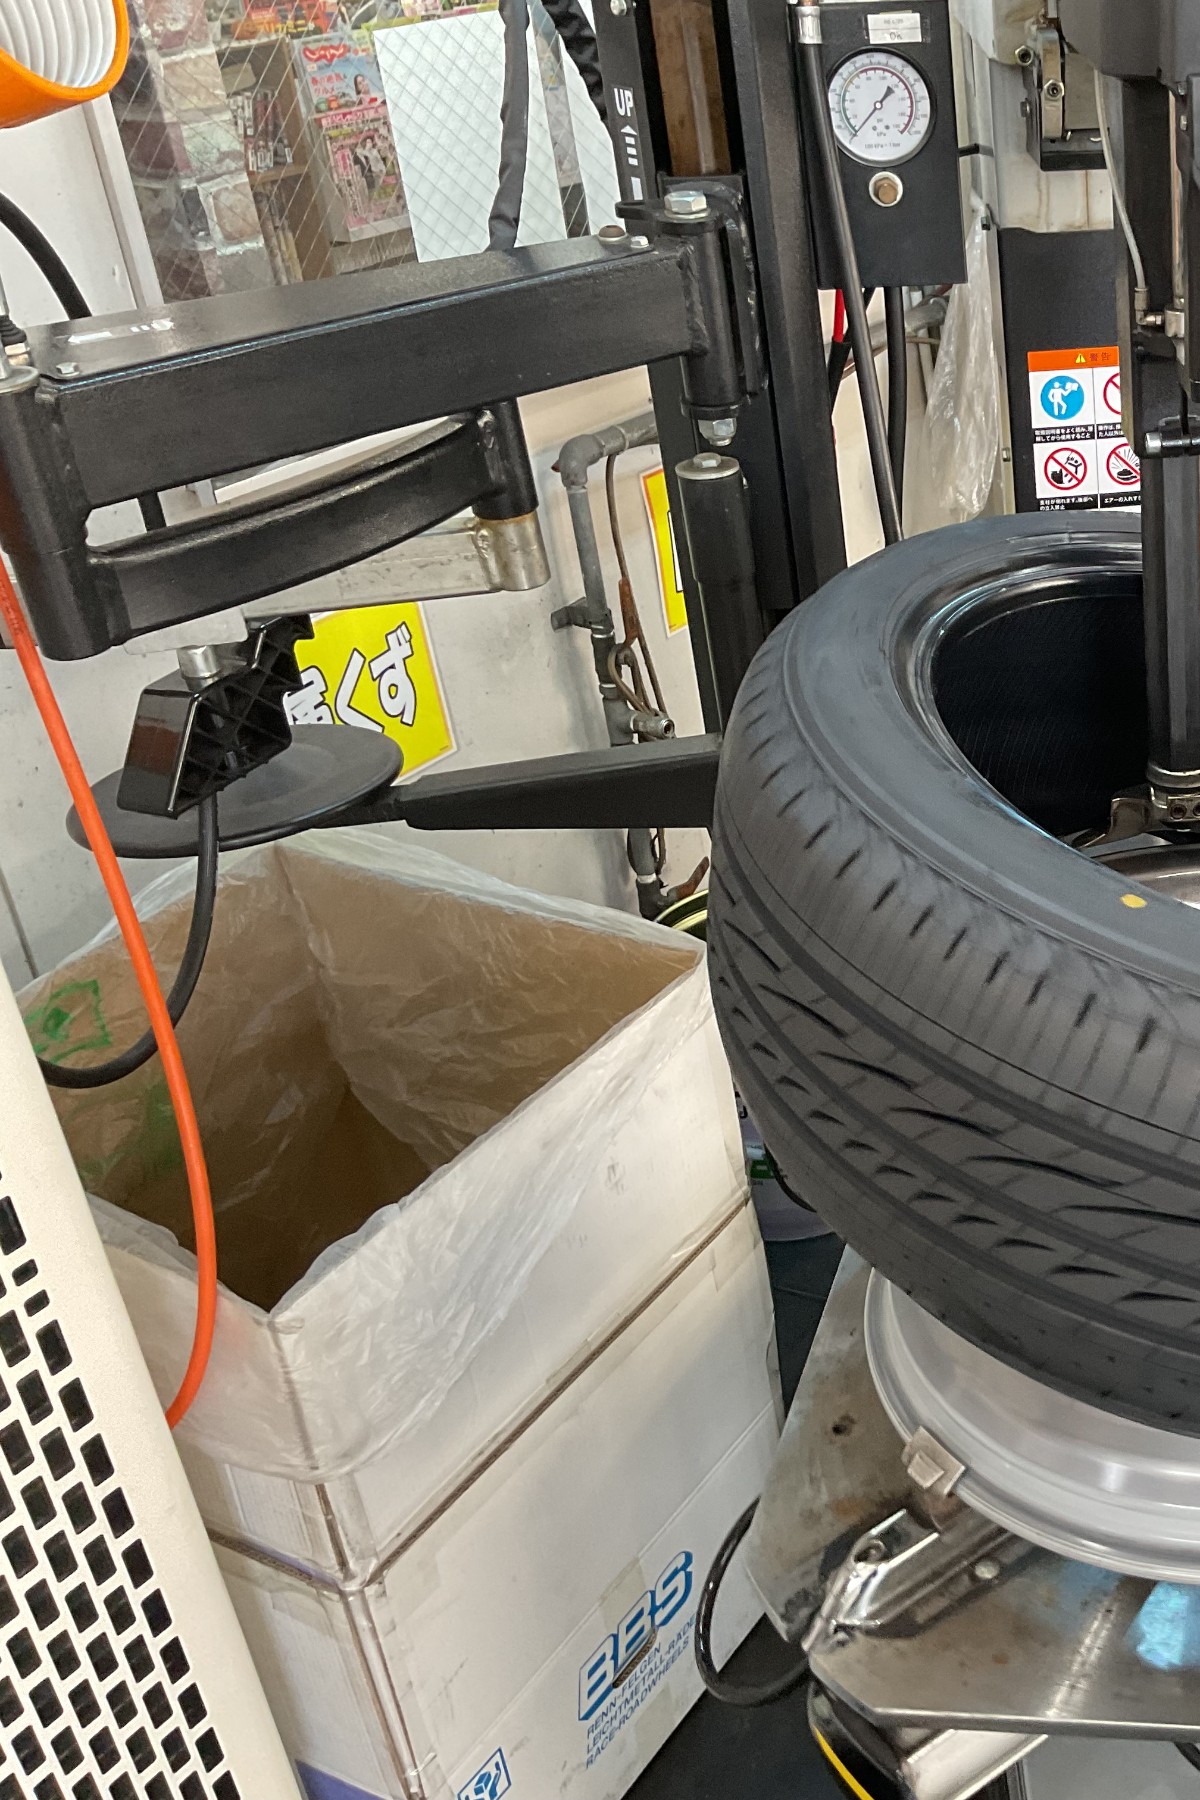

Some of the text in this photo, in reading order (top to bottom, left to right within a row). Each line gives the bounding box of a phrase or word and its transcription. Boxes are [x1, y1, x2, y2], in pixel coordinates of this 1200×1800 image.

[613, 87, 634, 117] UP
[578, 1550, 693, 1721] BBS
[587, 1642, 662, 1740] RENN-FELGEN
